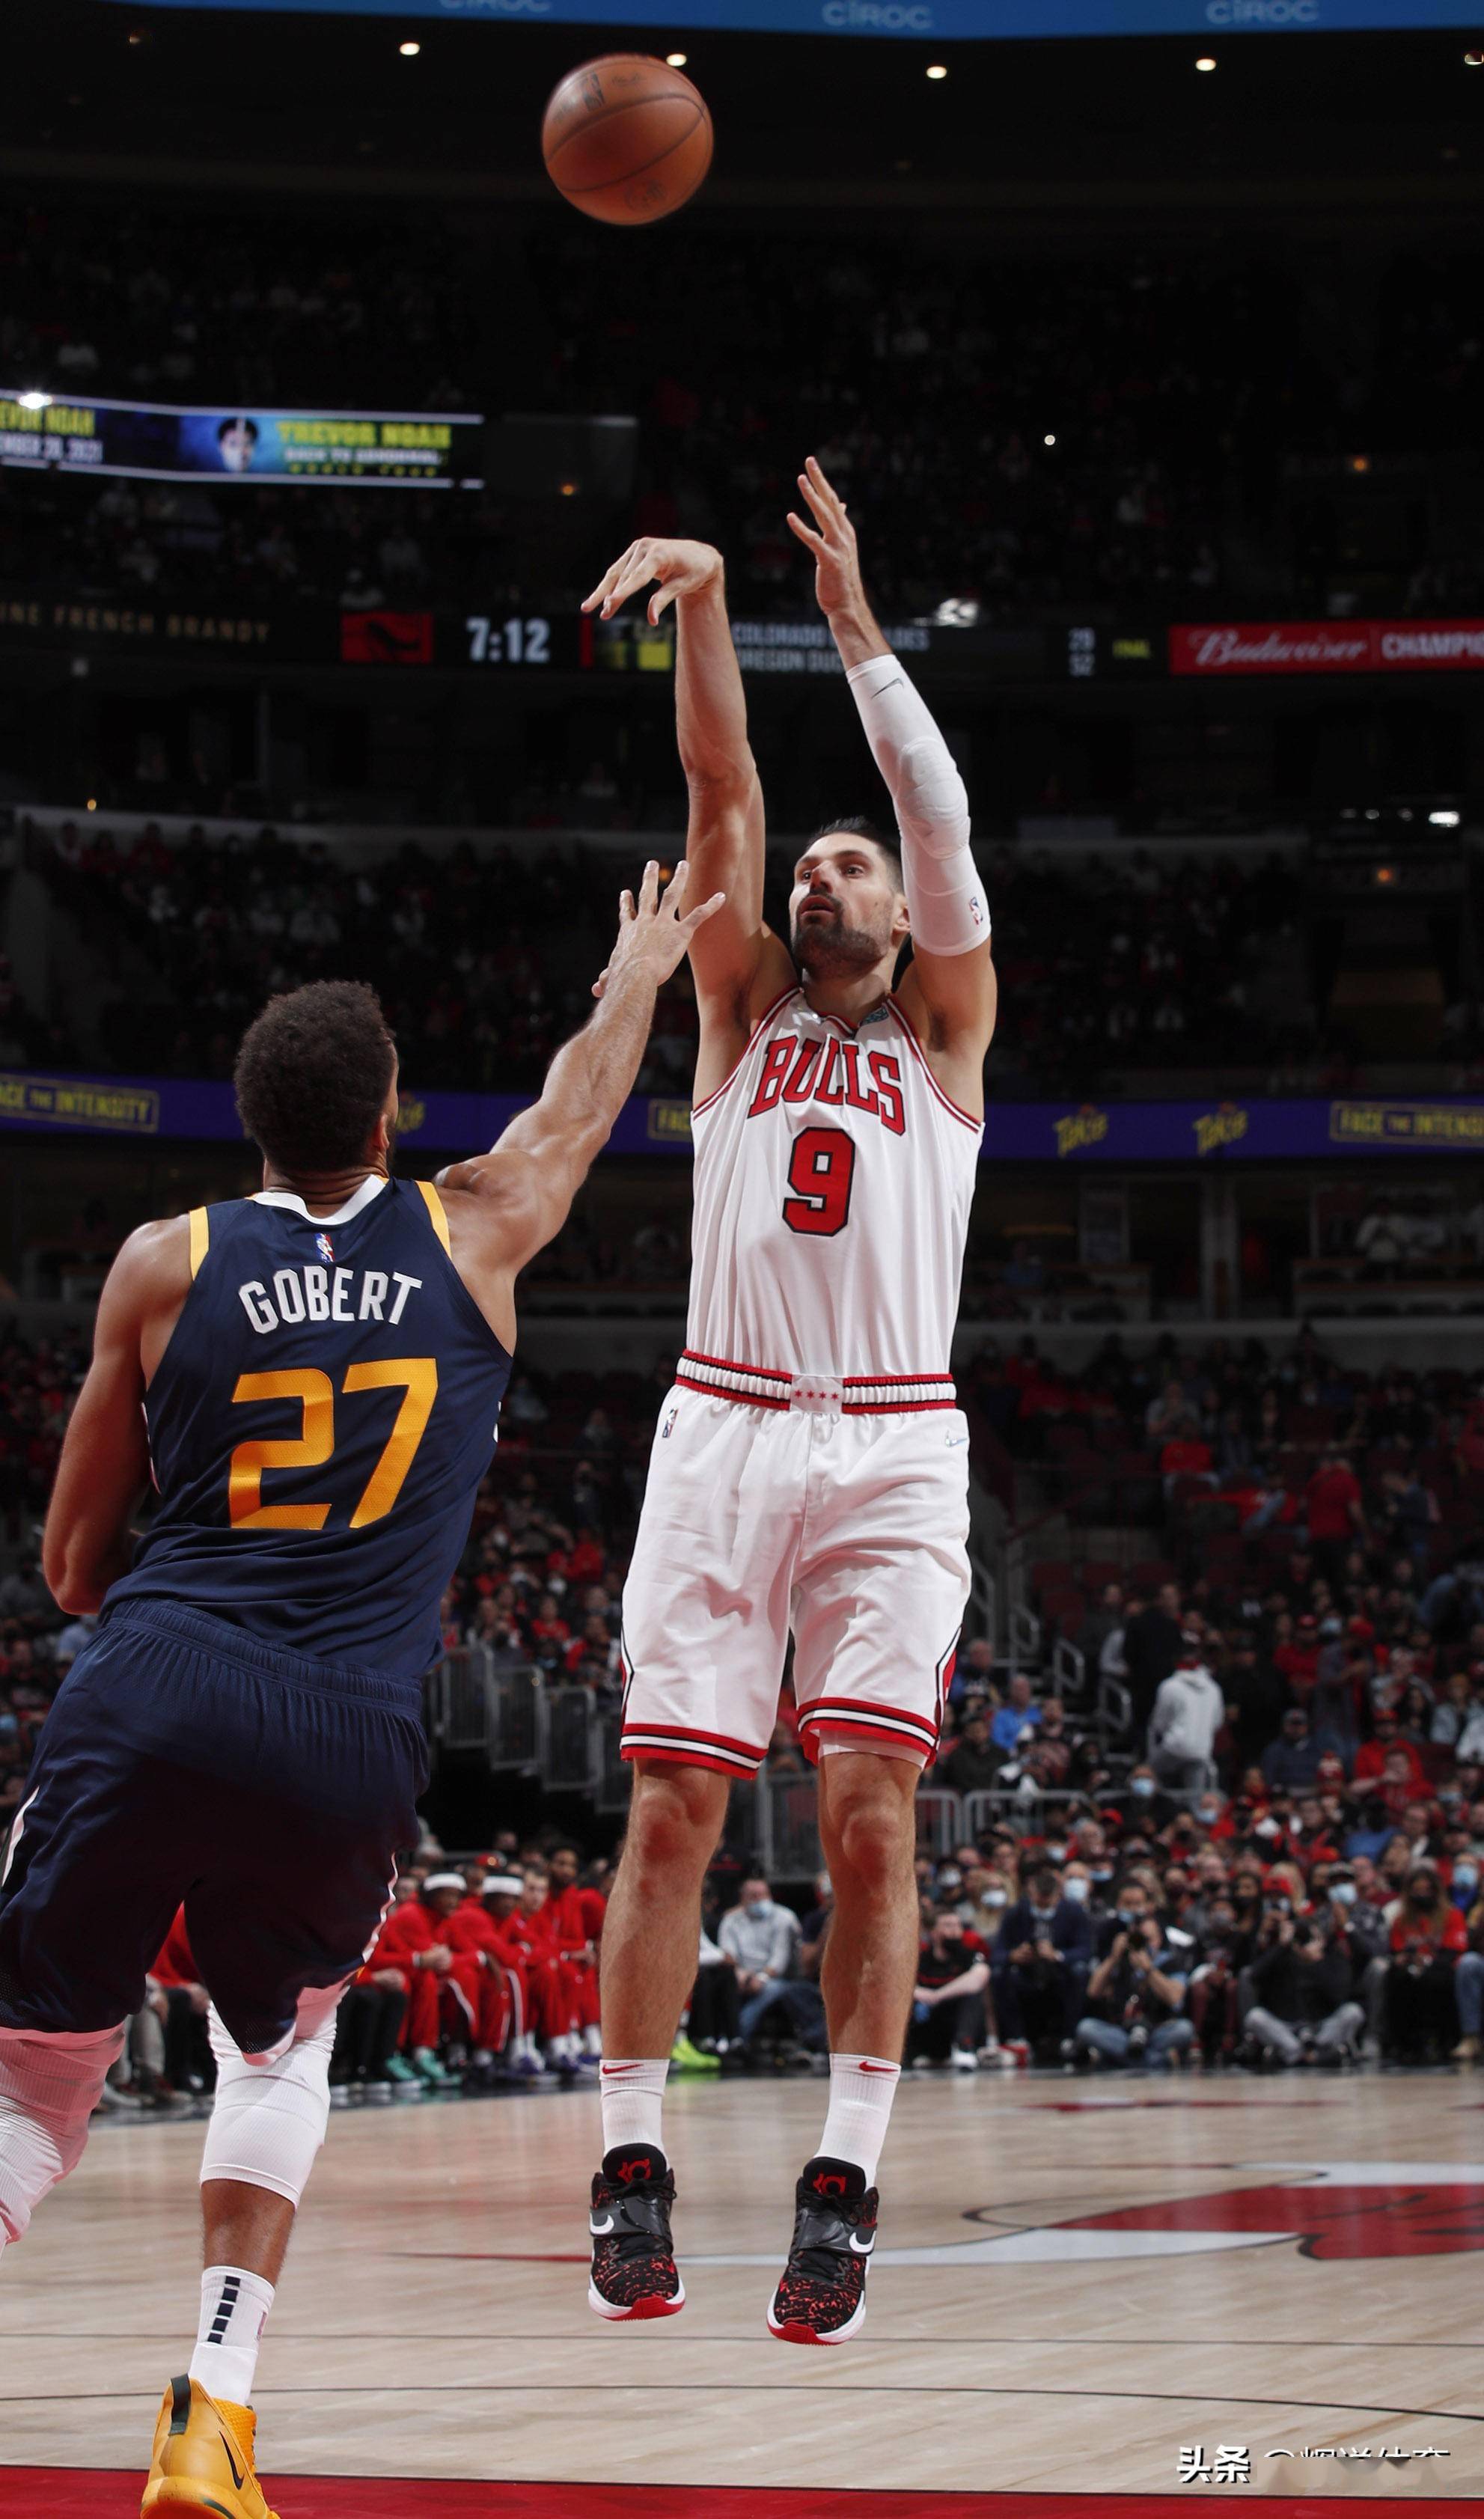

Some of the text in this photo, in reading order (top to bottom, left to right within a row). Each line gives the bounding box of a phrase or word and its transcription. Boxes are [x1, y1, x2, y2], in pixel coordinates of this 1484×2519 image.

[167, 614, 269, 643] BRANDY
[466, 617, 551, 663] 7:12
[1188, 626, 1368, 666] Budweiser
[747, 1033, 906, 1137] BULLS
[782, 1126, 856, 1237] 9
[238, 1265, 423, 1334] GOBERT
[229, 1358, 439, 1530] 27
